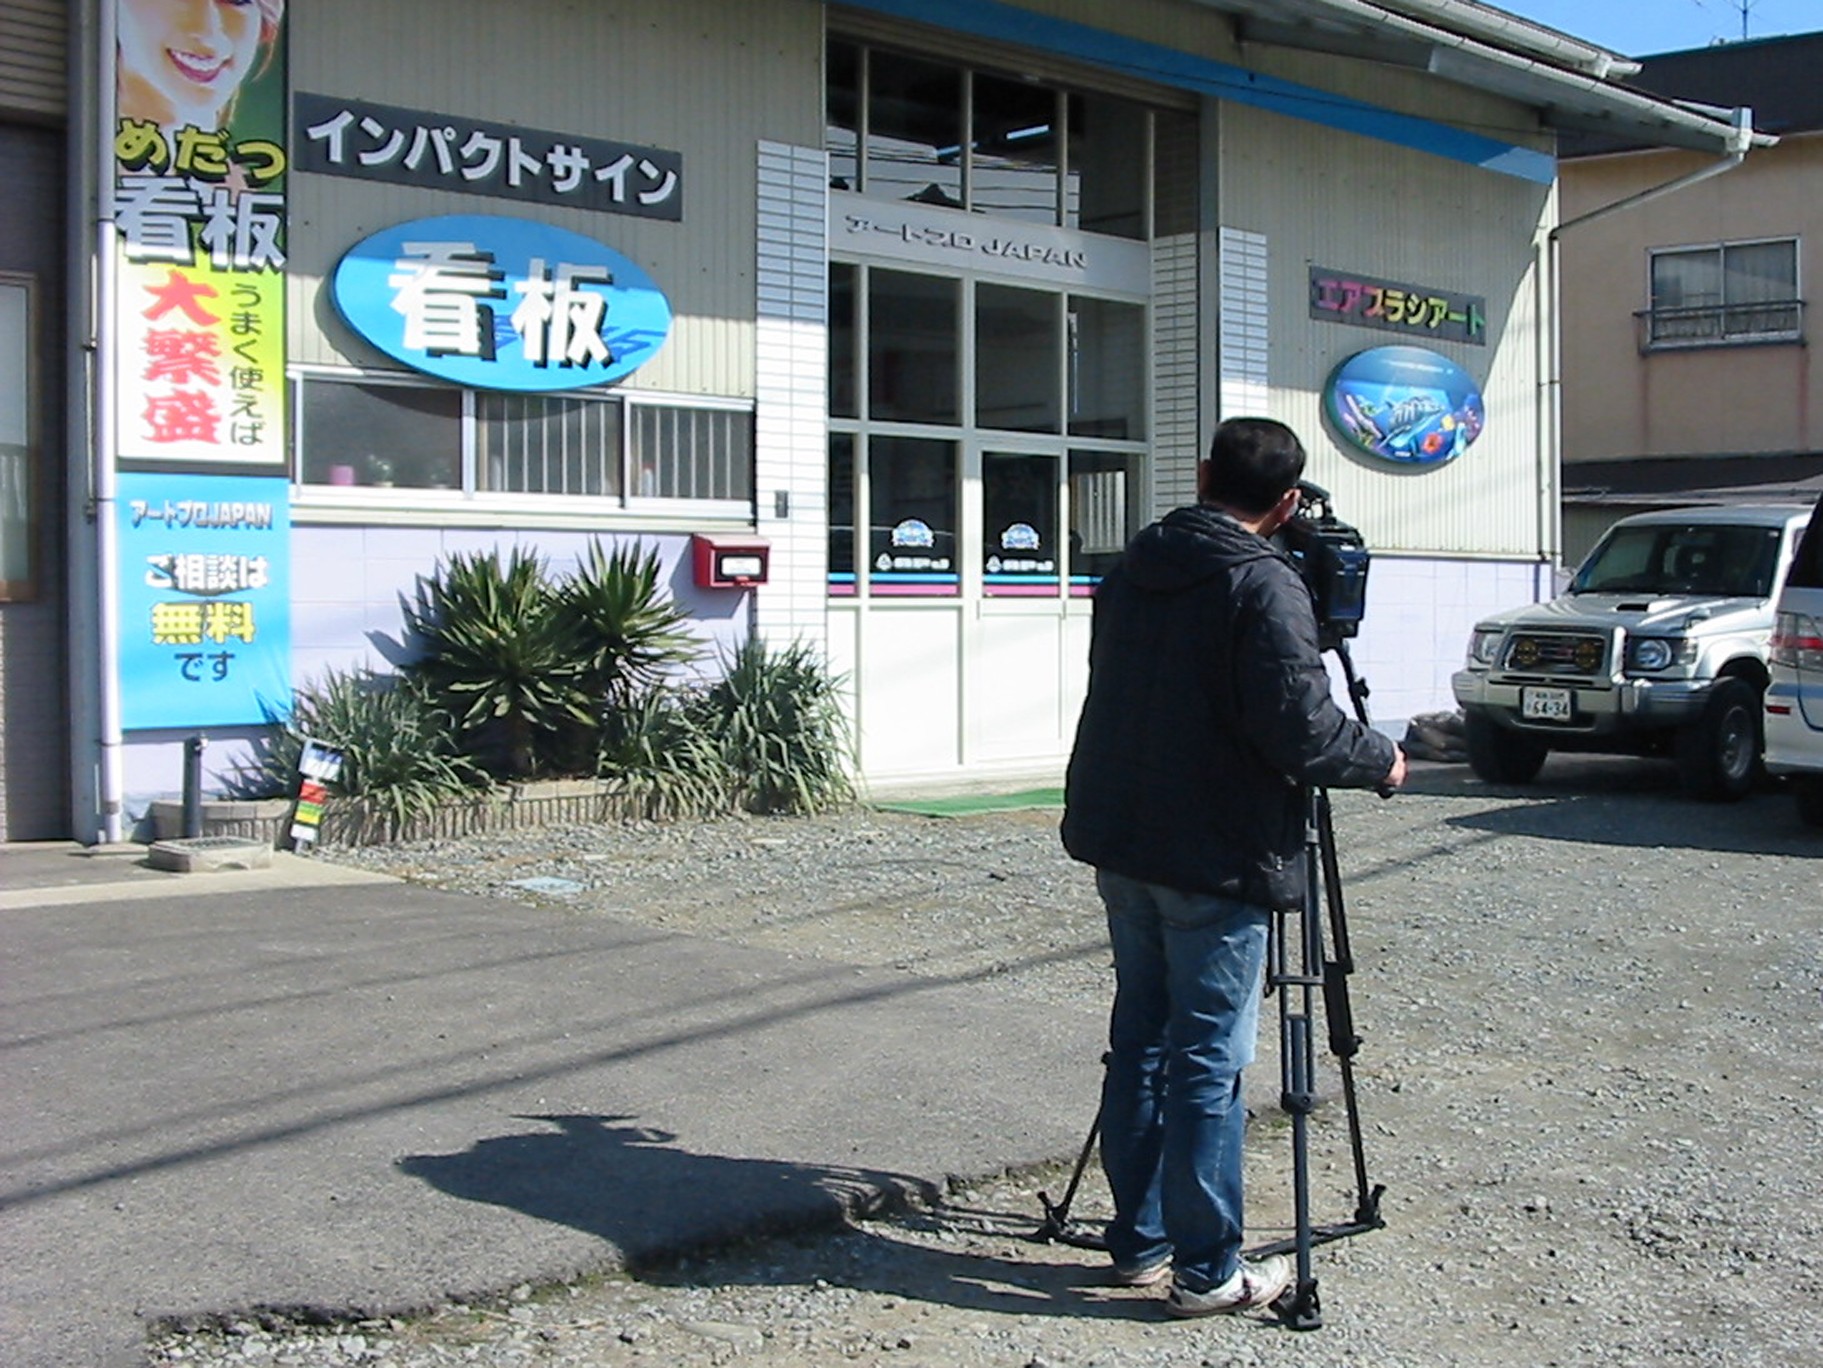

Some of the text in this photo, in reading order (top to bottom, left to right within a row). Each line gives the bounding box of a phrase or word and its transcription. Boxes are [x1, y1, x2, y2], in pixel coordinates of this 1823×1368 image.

[116, 118, 287, 188] めだつ
[306, 110, 678, 205] インパクトサイン
[114, 175, 287, 273] 看板
[981, 238, 1087, 270] JAPAN
[388, 242, 612, 368] 看板
[141, 268, 222, 445] 大繁盛
[229, 283, 264, 446] うまく使えば
[145, 554, 267, 590] ご相談は
[152, 602, 255, 644] 無料
[175, 651, 236, 682] です
